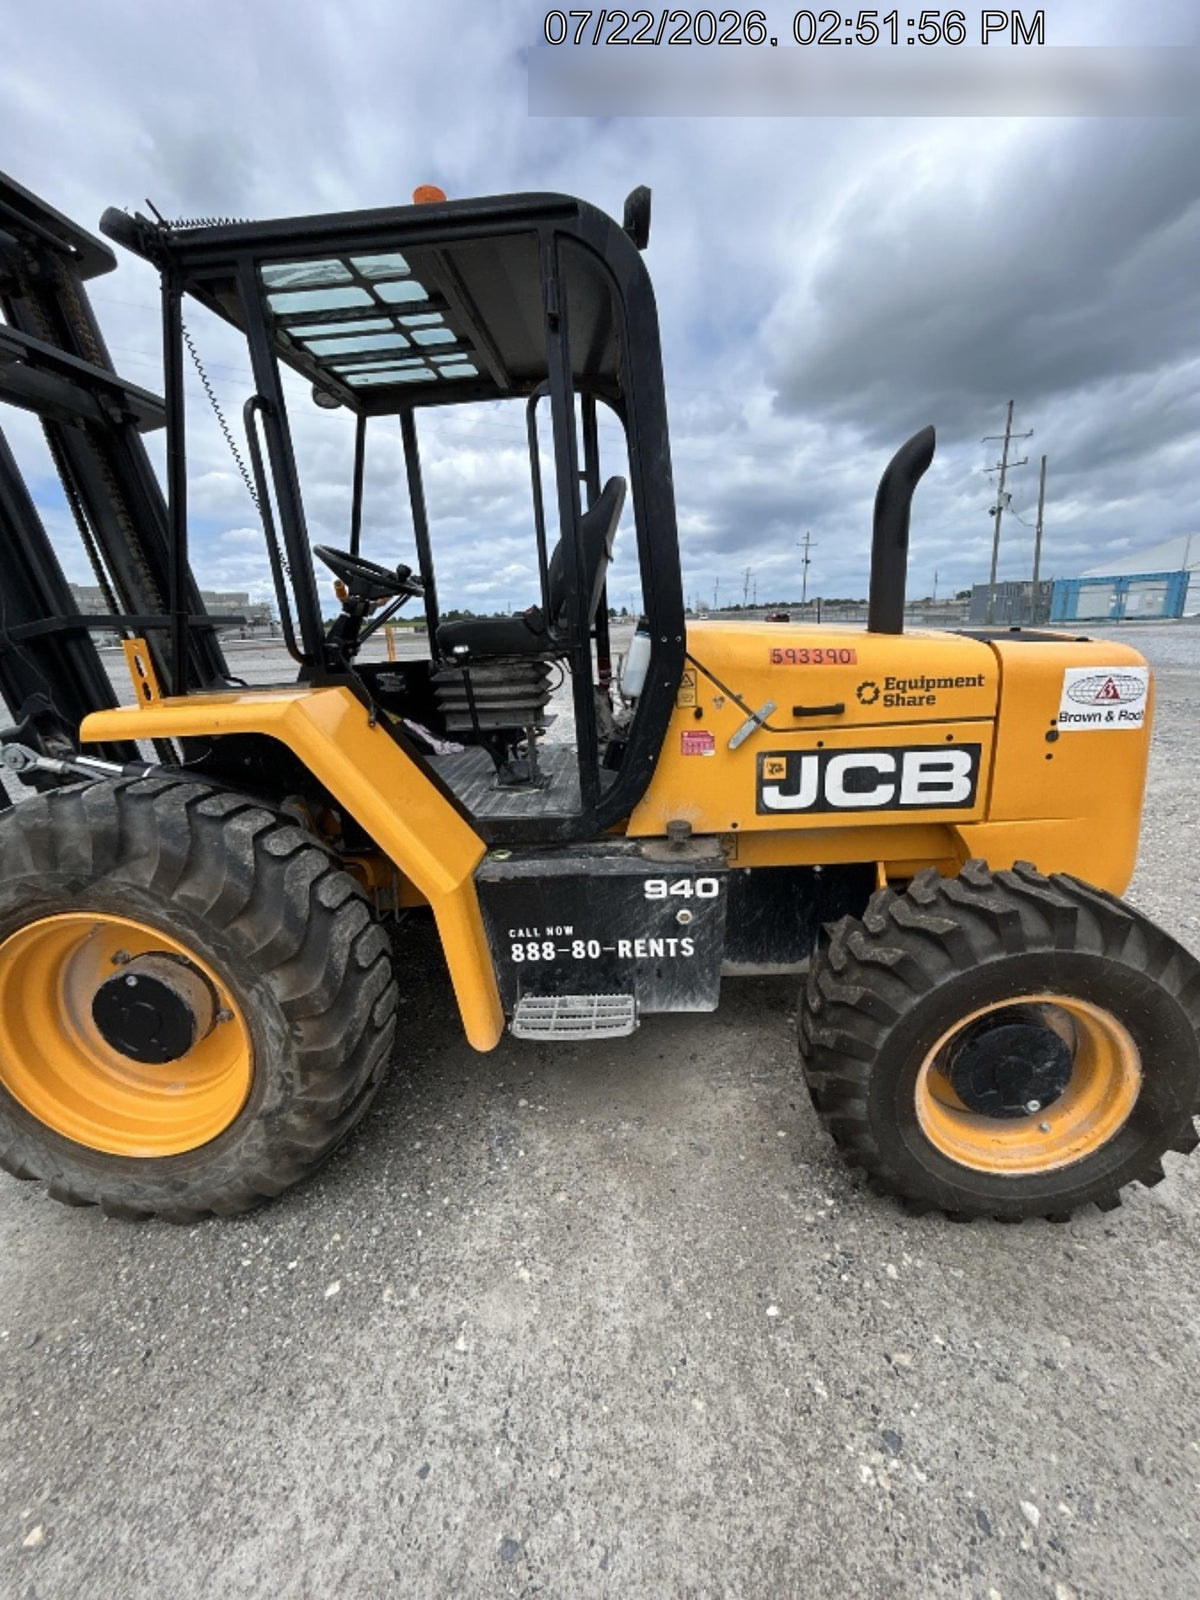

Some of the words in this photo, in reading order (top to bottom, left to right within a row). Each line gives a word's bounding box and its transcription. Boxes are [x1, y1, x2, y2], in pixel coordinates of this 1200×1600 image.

[772, 649, 851, 664] 593390
[884, 674, 985, 693] Equipment
[883, 691, 936, 708] Share
[1059, 711, 1101, 723] Brown
[1105, 710, 1115, 723] &
[762, 750, 972, 811] JCB
[644, 878, 720, 899] 940
[508, 927, 541, 938] CALL
[546, 925, 574, 937] NOW
[511, 937, 695, 963] 888-80-RENTS
